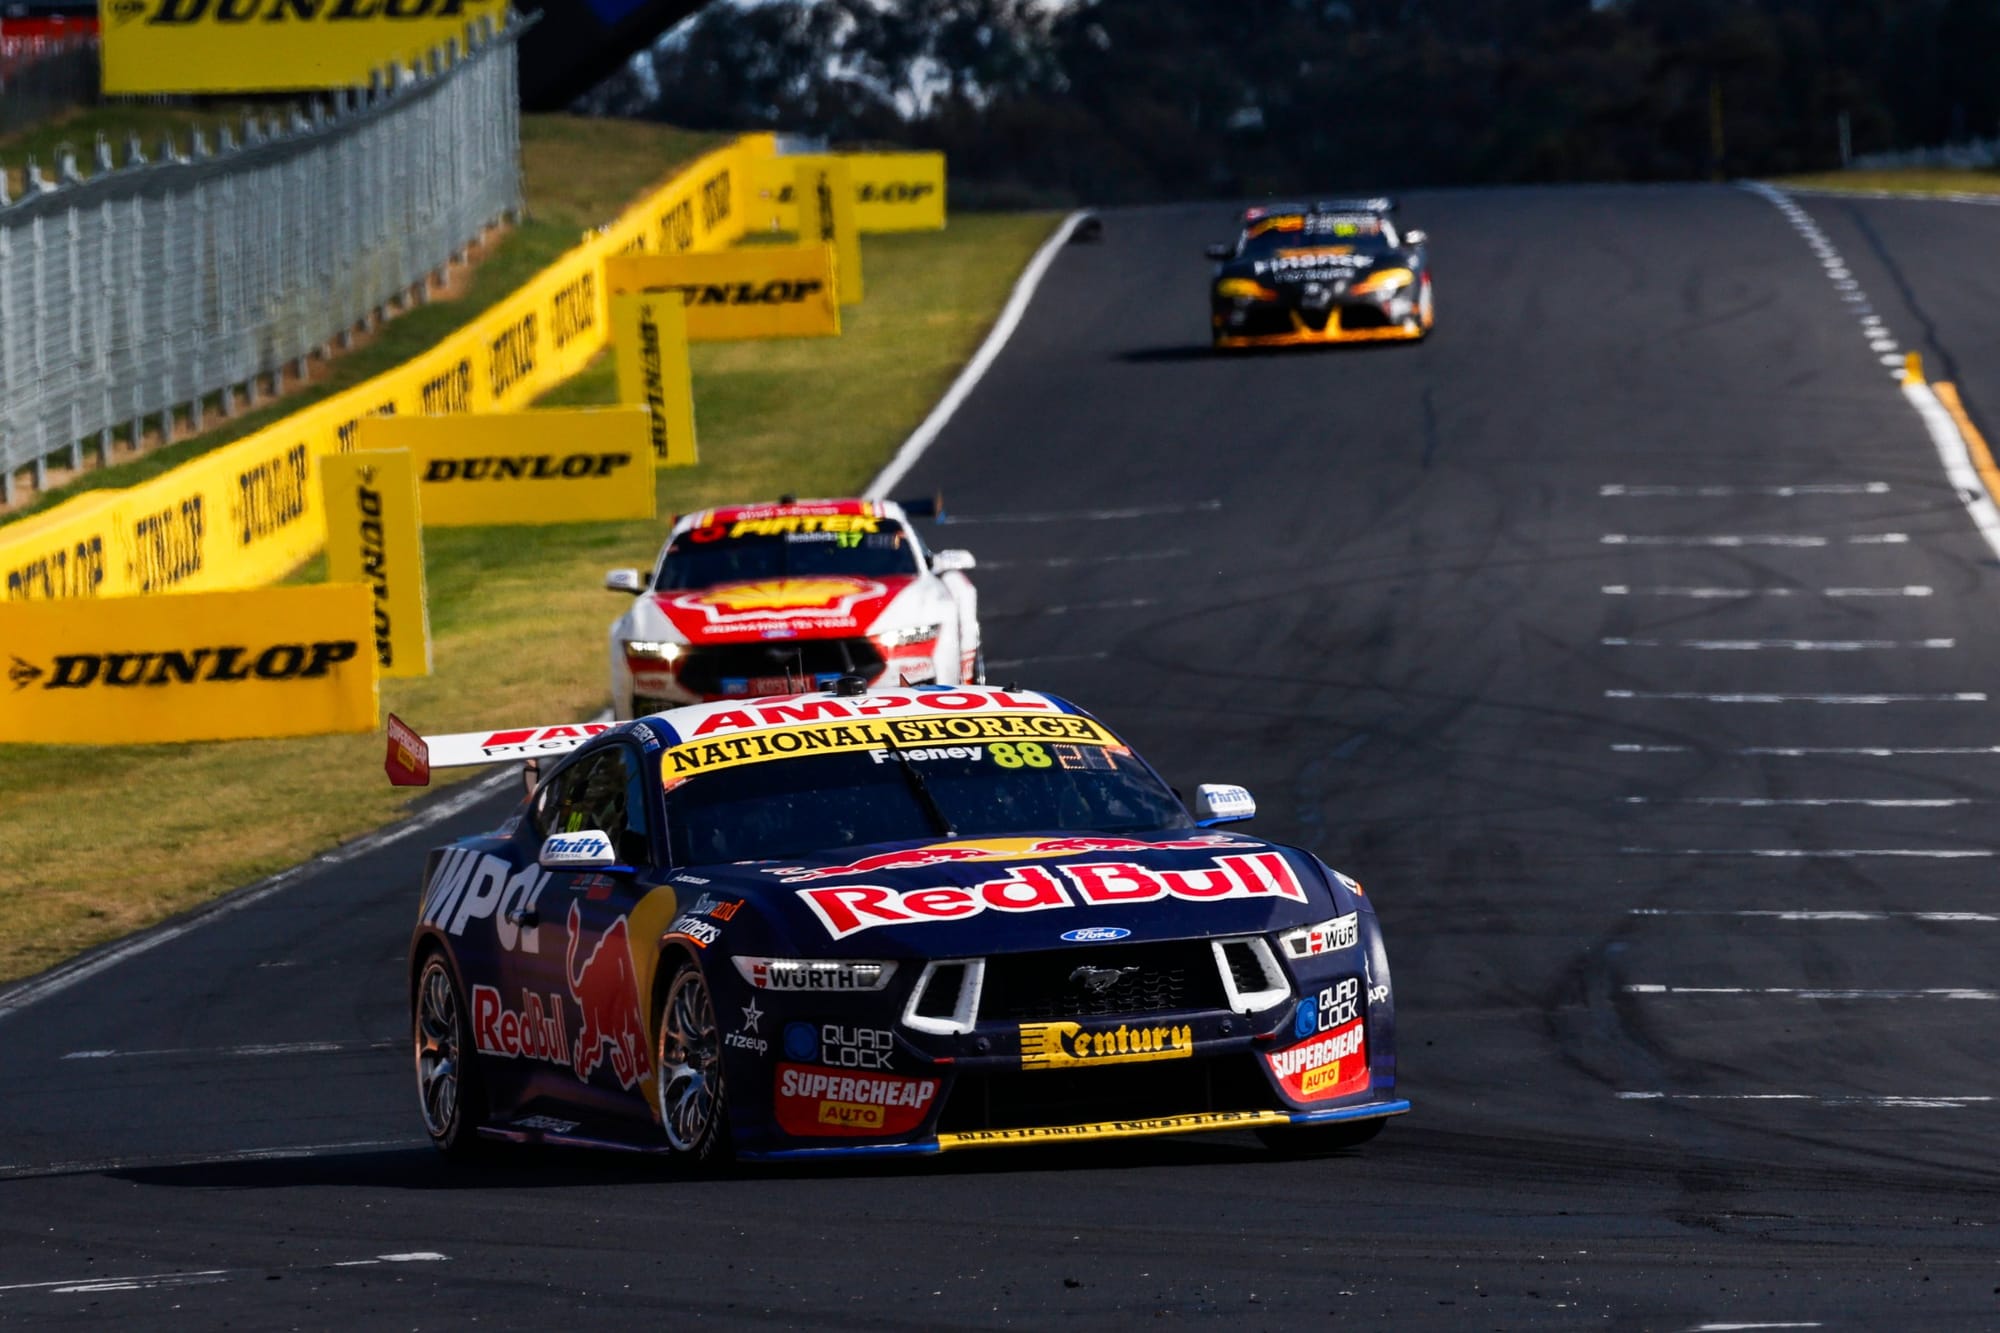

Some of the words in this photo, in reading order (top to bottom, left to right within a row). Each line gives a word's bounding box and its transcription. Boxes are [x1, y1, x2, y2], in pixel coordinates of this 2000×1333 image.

[423, 453, 631, 483] DUNLOP
[728, 514, 880, 539] PIRTEK
[836, 531, 863, 549] 17
[44, 640, 359, 690] DUNLOP
[692, 691, 1050, 736] AMPOL
[669, 725, 887, 773] NATIONAL
[893, 715, 1092, 741] STORAGE
[869, 745, 983, 766] Feeney
[987, 742, 1053, 769] 88
[545, 838, 607, 857] Thrifty
[797, 866, 1075, 940] Red
[1052, 851, 1309, 904] Bull
[770, 969, 855, 989] WÜRTH
[1318, 977, 1358, 1010] QUAD
[472, 984, 538, 1059] Red
[529, 991, 571, 1066] Bull
[1318, 998, 1358, 1032] LOCK
[725, 1029, 768, 1057] rizeup
[822, 1024, 894, 1050] QUAD
[1050, 1022, 1193, 1059] Century
[1271, 1023, 1364, 1079] SUPERCHEAP
[822, 1045, 895, 1070] LOCK
[781, 1069, 935, 1109] SUPERCHEAP
[1306, 1067, 1336, 1089] AUTO
[825, 1106, 877, 1124] AUTO
